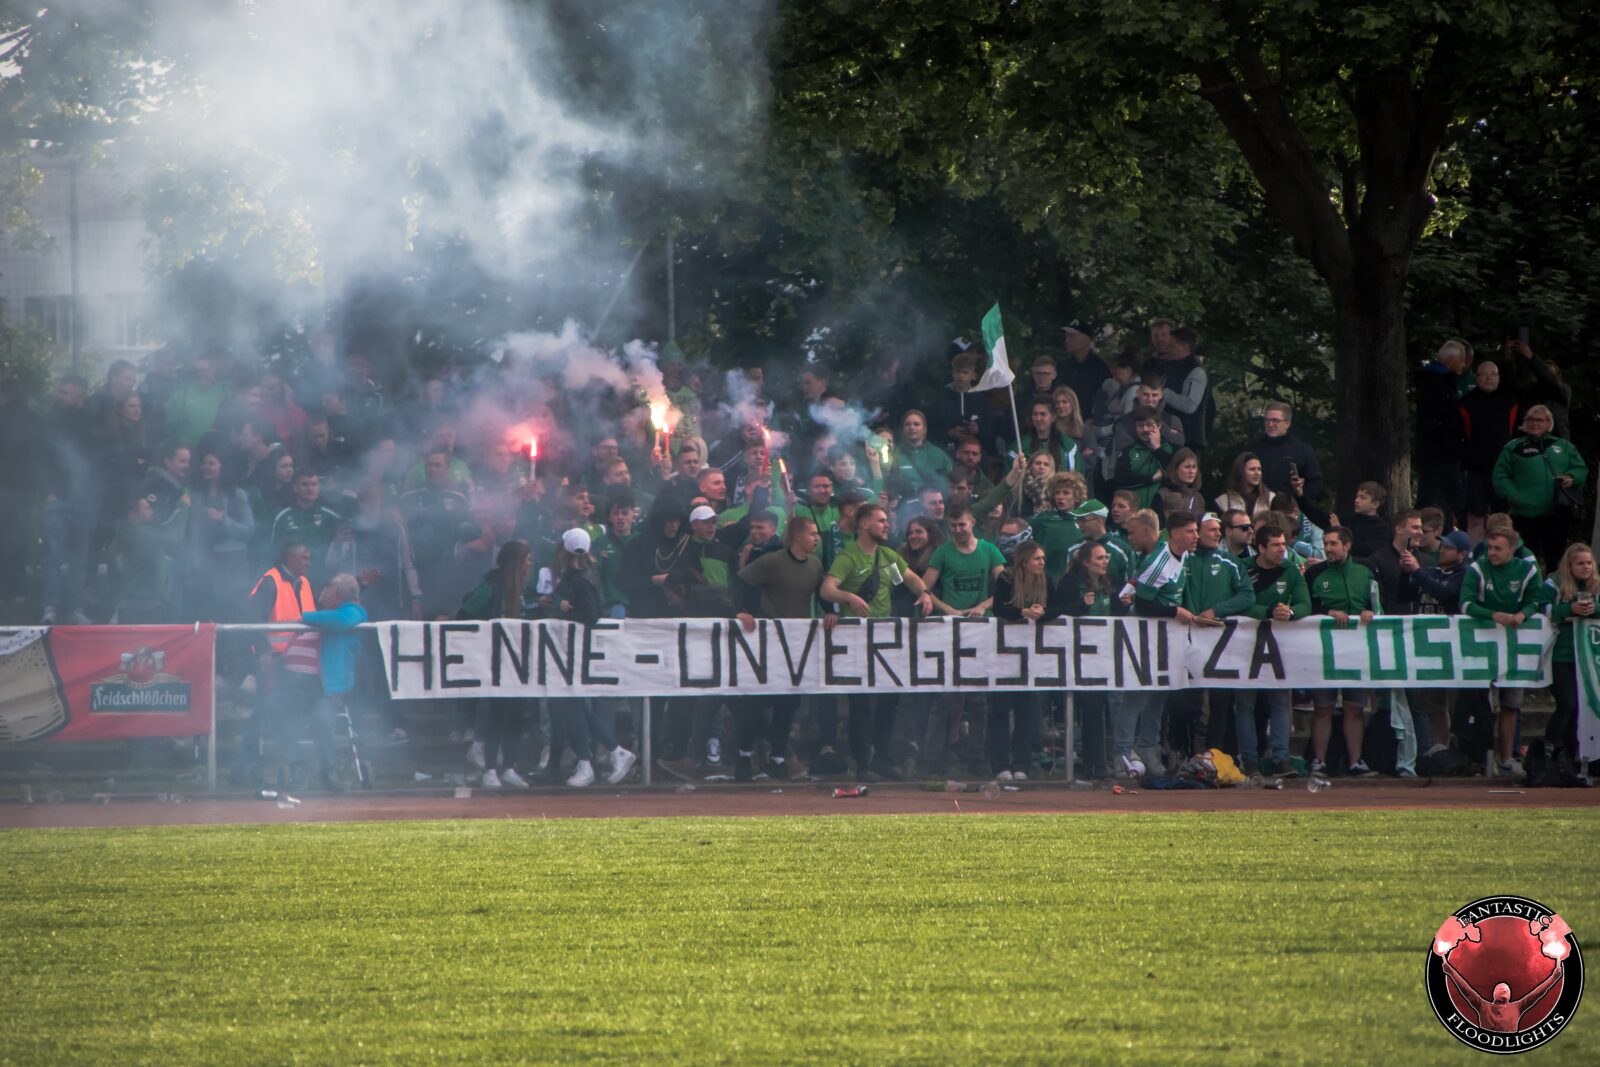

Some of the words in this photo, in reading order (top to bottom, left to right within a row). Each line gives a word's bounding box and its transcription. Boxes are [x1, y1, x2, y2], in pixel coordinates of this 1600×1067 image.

[390, 622, 620, 691] HENNE
[1203, 619, 1285, 679] ZA
[1320, 617, 1544, 681] COSSE
[93, 686, 187, 710] Feldschlößchen
